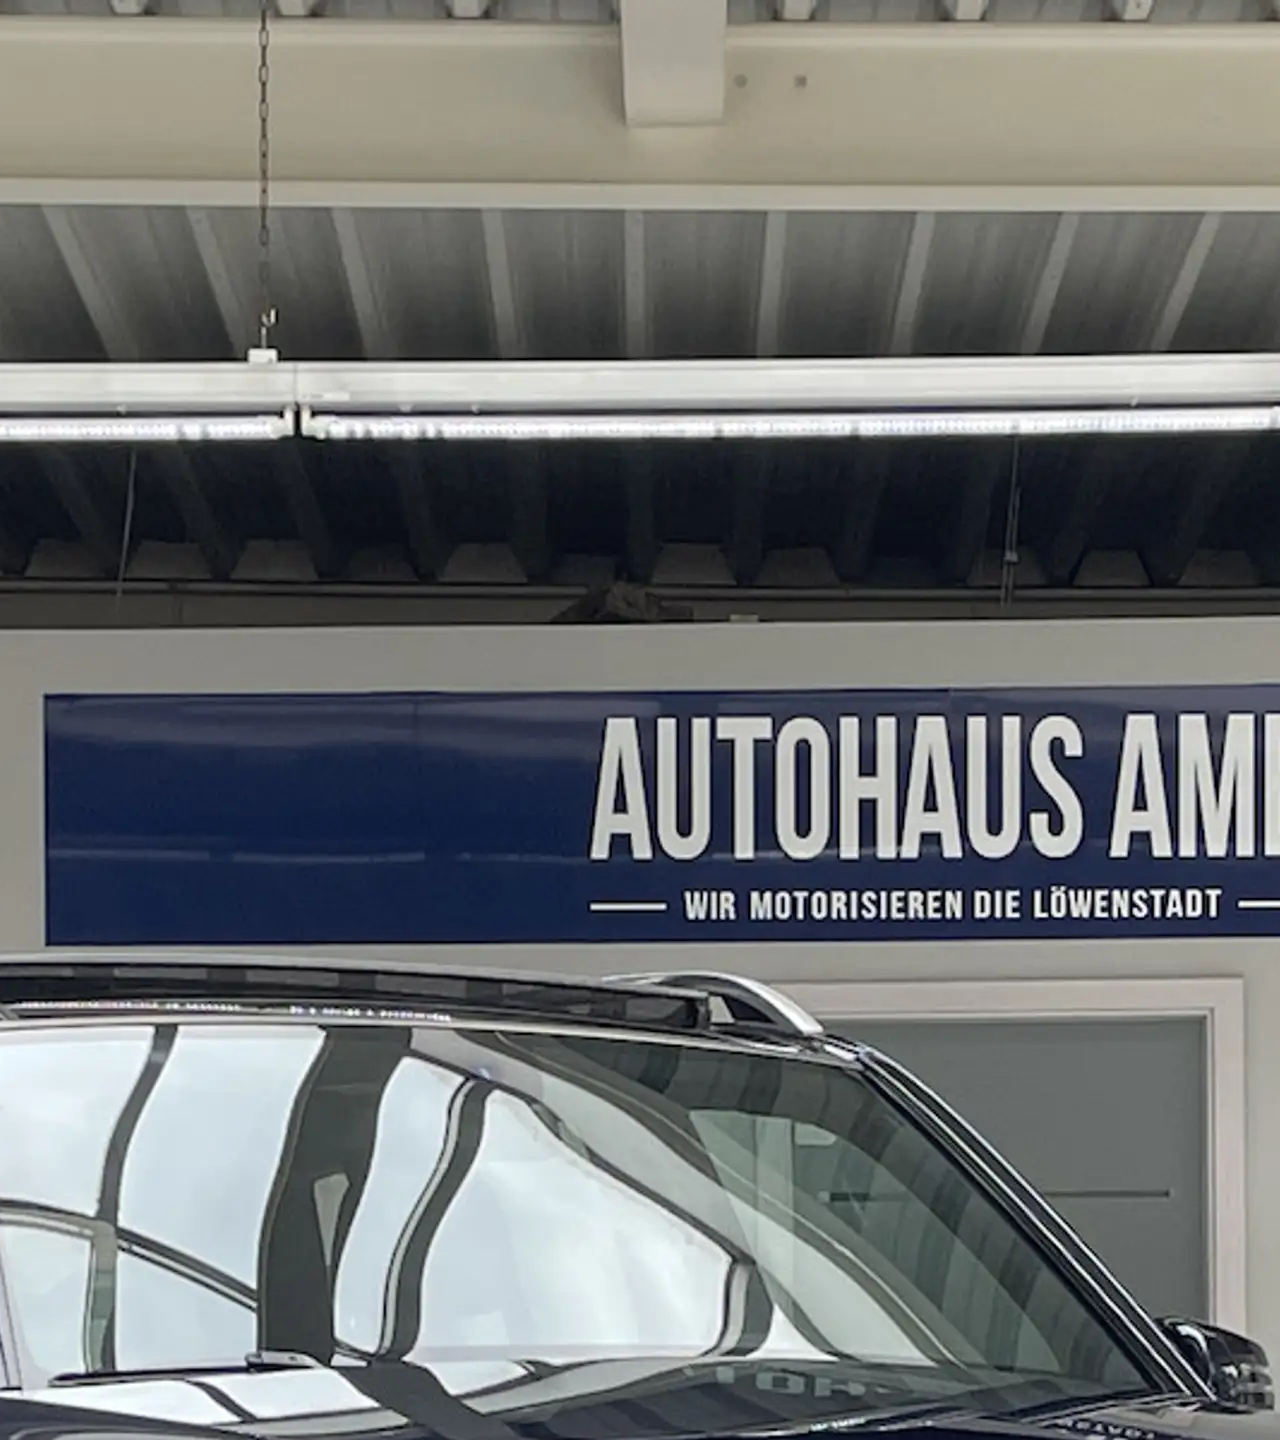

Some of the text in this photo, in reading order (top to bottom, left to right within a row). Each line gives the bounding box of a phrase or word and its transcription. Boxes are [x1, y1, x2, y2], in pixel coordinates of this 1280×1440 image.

[589, 714, 1084, 861] AUTOHAUS
[684, 885, 1223, 920] WIR MOTORISIEREN DIE LÖWENSTADT
